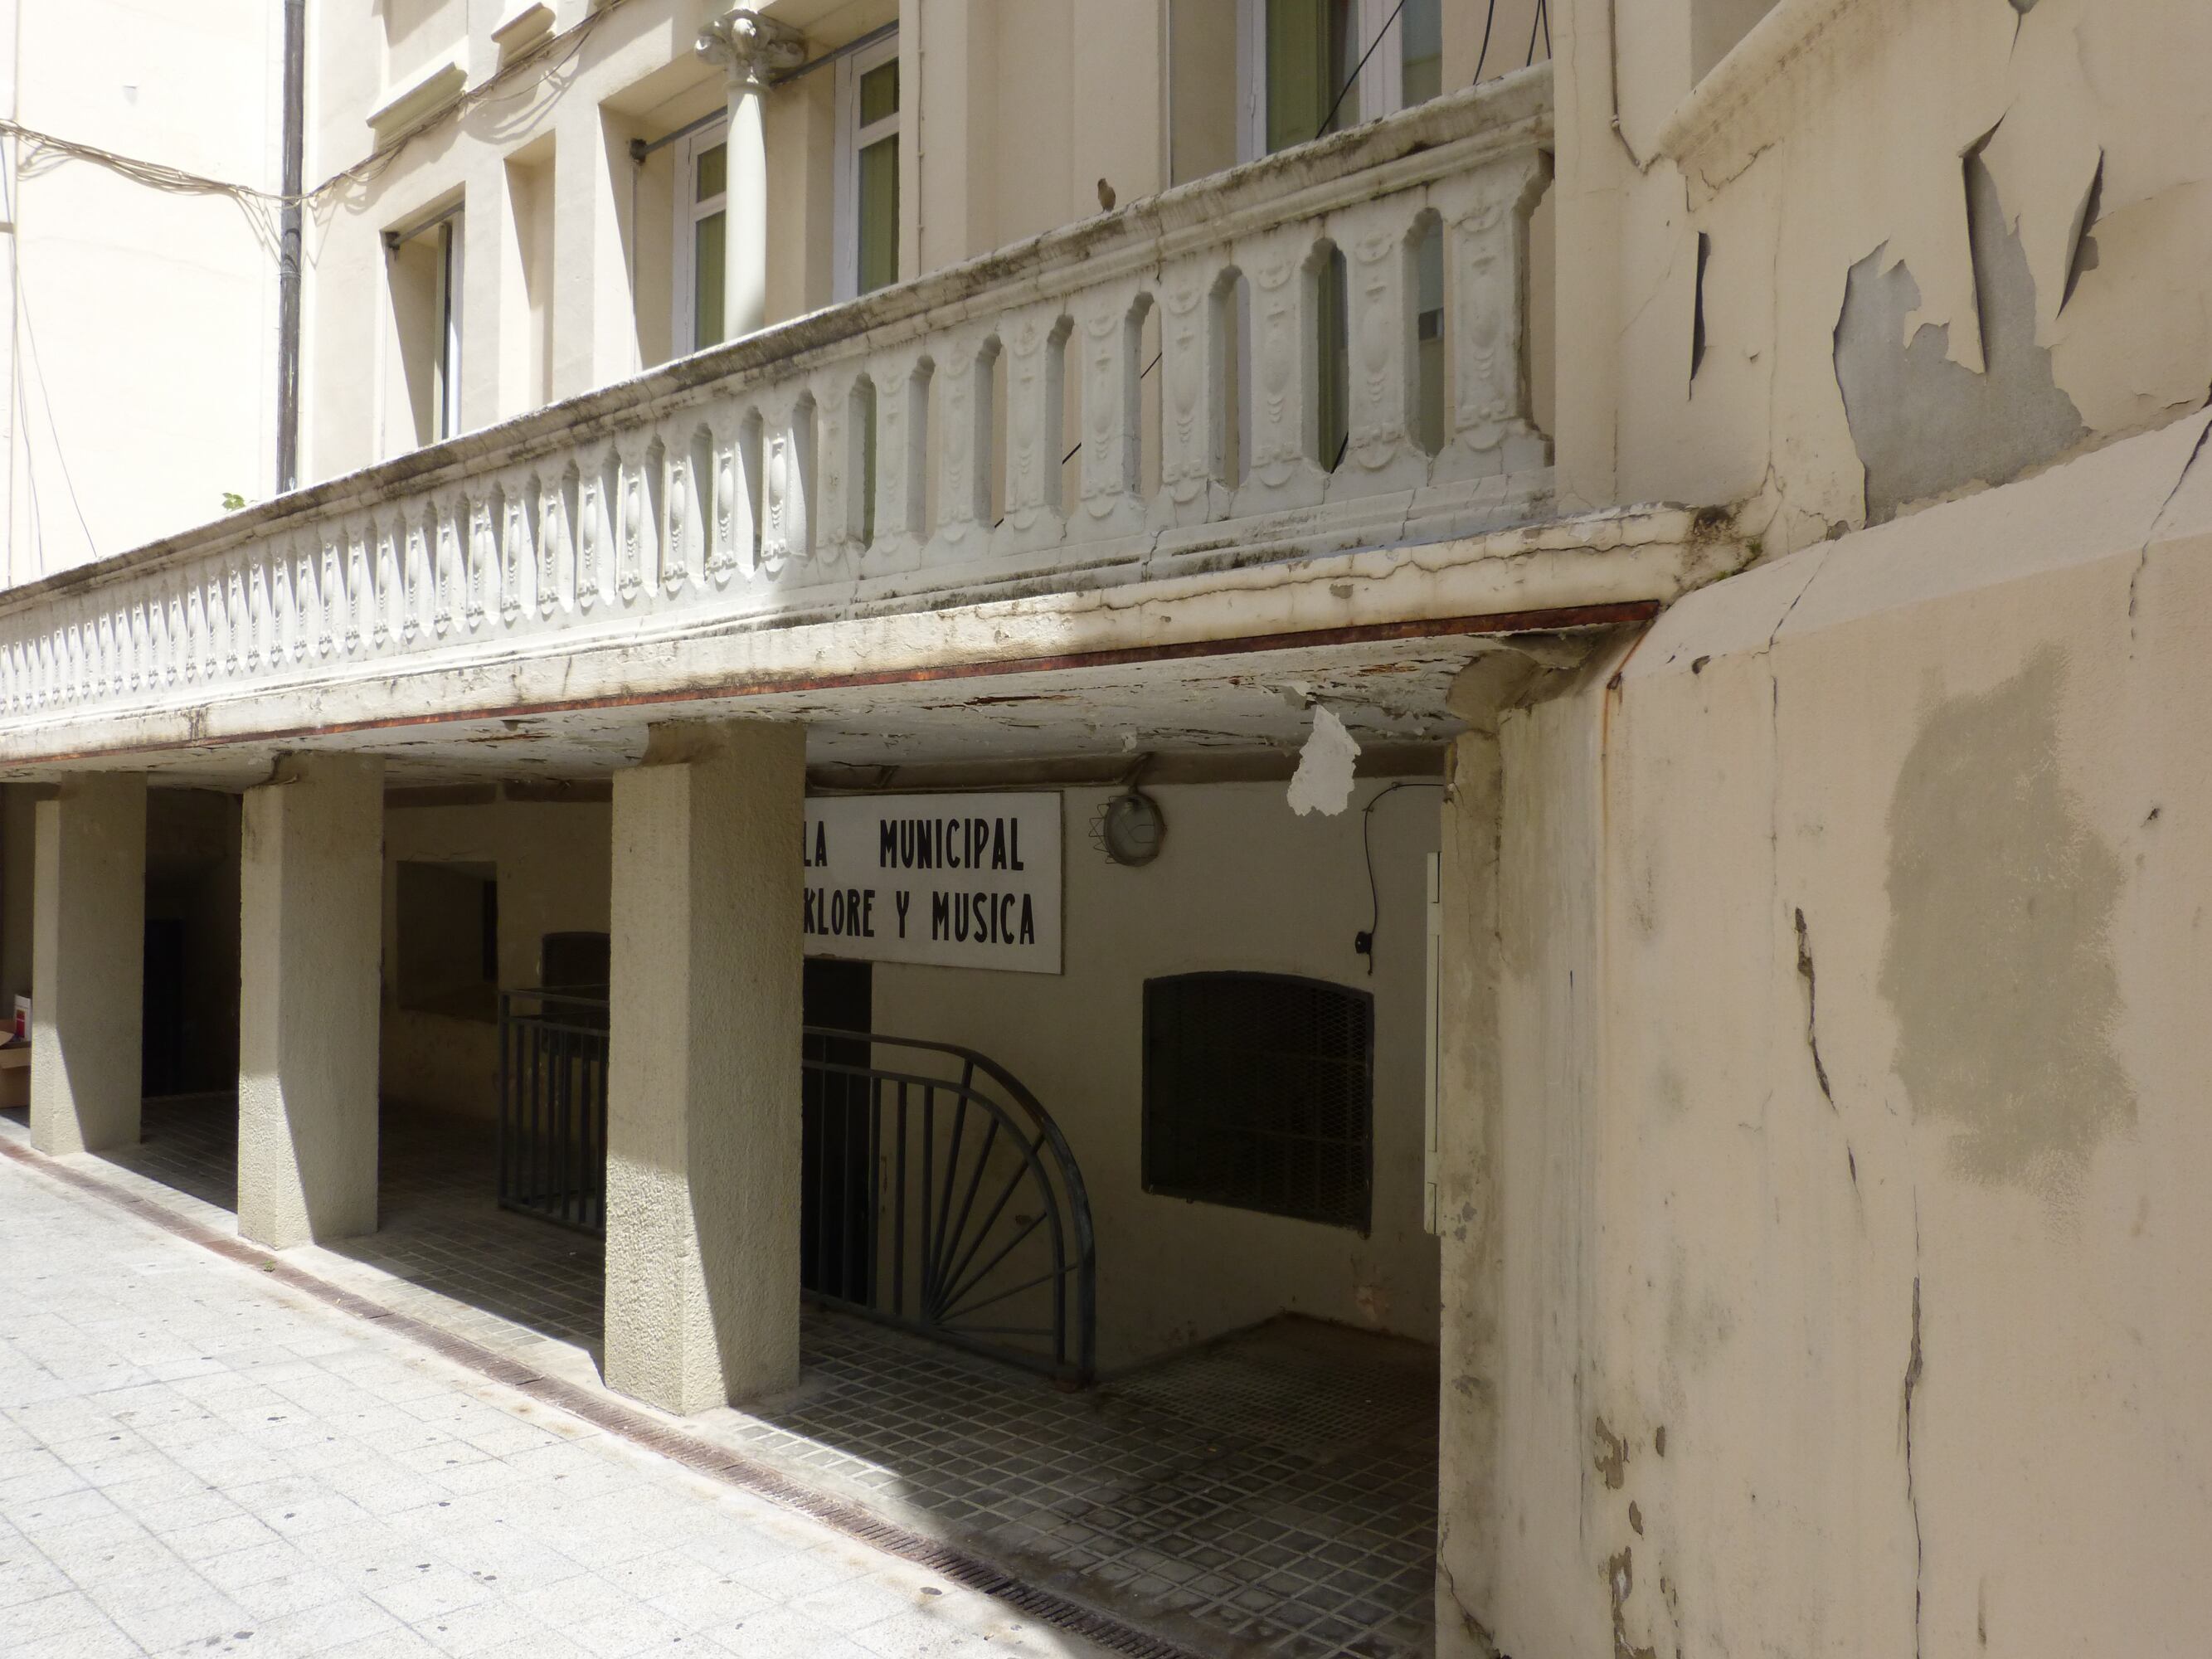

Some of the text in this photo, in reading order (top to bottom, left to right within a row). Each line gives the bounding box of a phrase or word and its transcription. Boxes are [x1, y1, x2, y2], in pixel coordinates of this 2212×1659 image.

[804, 817, 1024, 871] LA MUNICIPAL
[804, 888, 1035, 945] KLORE Y MUSICA
